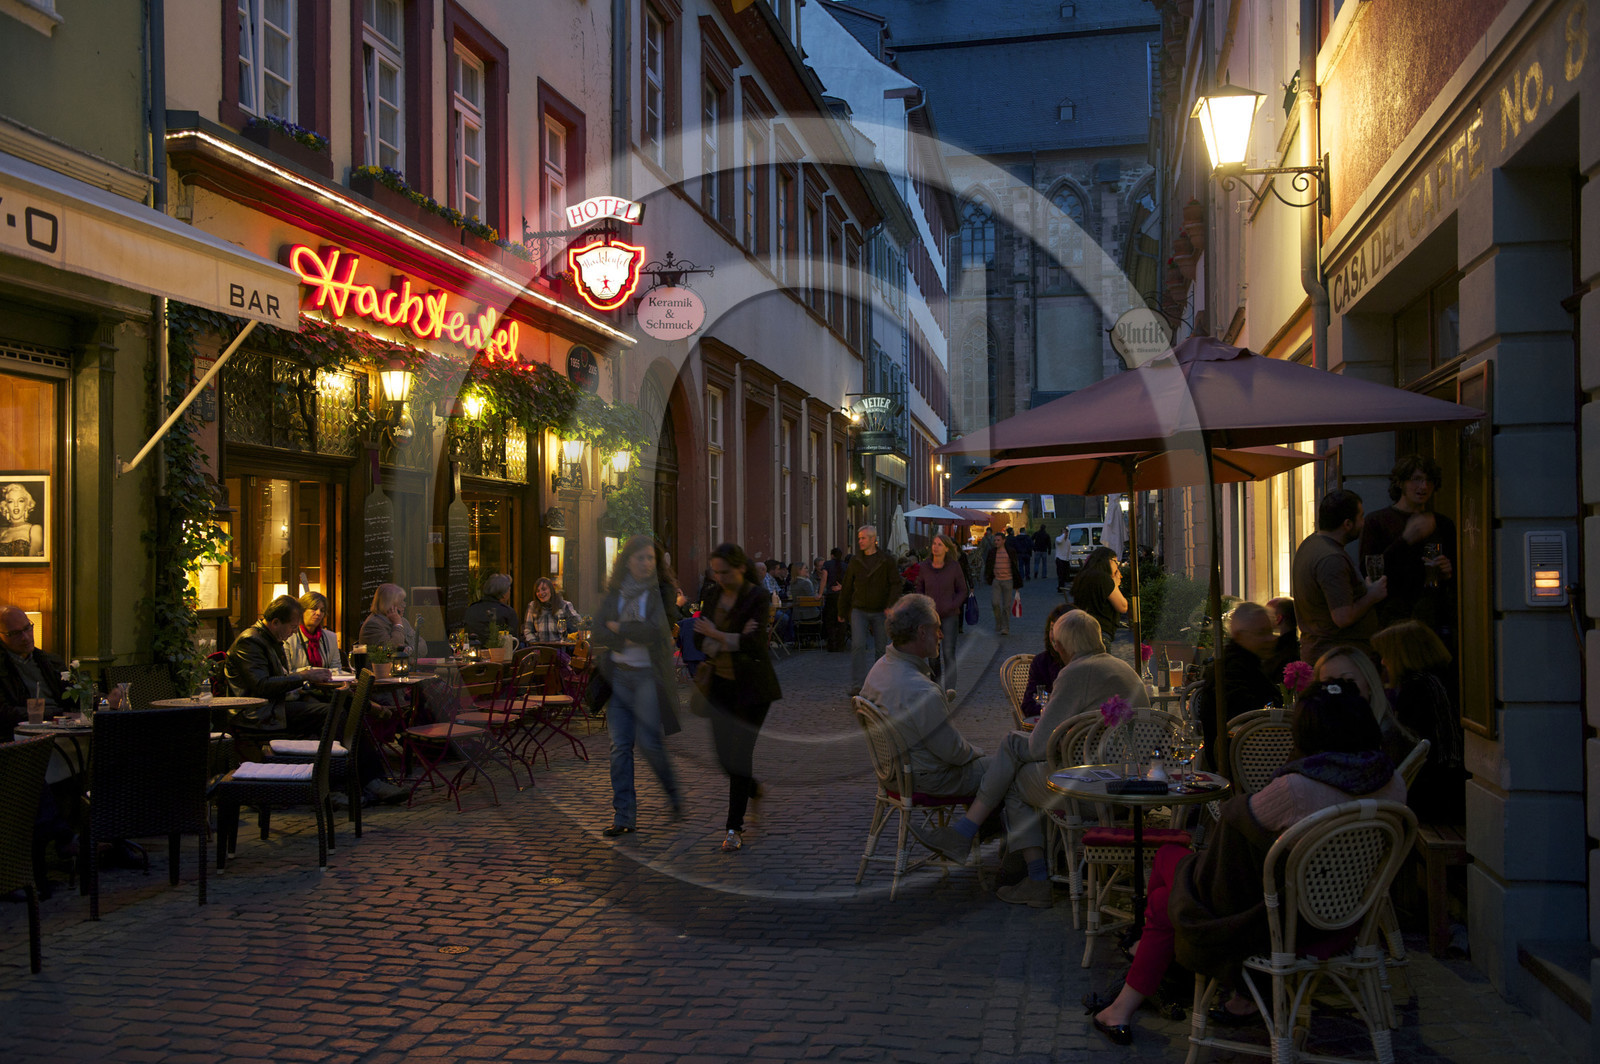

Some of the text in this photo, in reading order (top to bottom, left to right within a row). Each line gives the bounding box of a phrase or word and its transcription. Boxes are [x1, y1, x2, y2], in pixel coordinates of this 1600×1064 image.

[1333, 247, 1368, 314] CASA
[1371, 220, 1405, 279] DEL
[1499, 61, 1554, 152] NO.
[1564, 1, 1589, 82] 8
[570, 199, 636, 224] HOTEL
[230, 283, 281, 318] BAR
[648, 297, 693, 308] Keramik
[665, 309, 674, 319] &
[645, 319, 694, 330] Schmuck
[1117, 321, 1166, 345] Antik
[862, 397, 891, 409] VETTER
